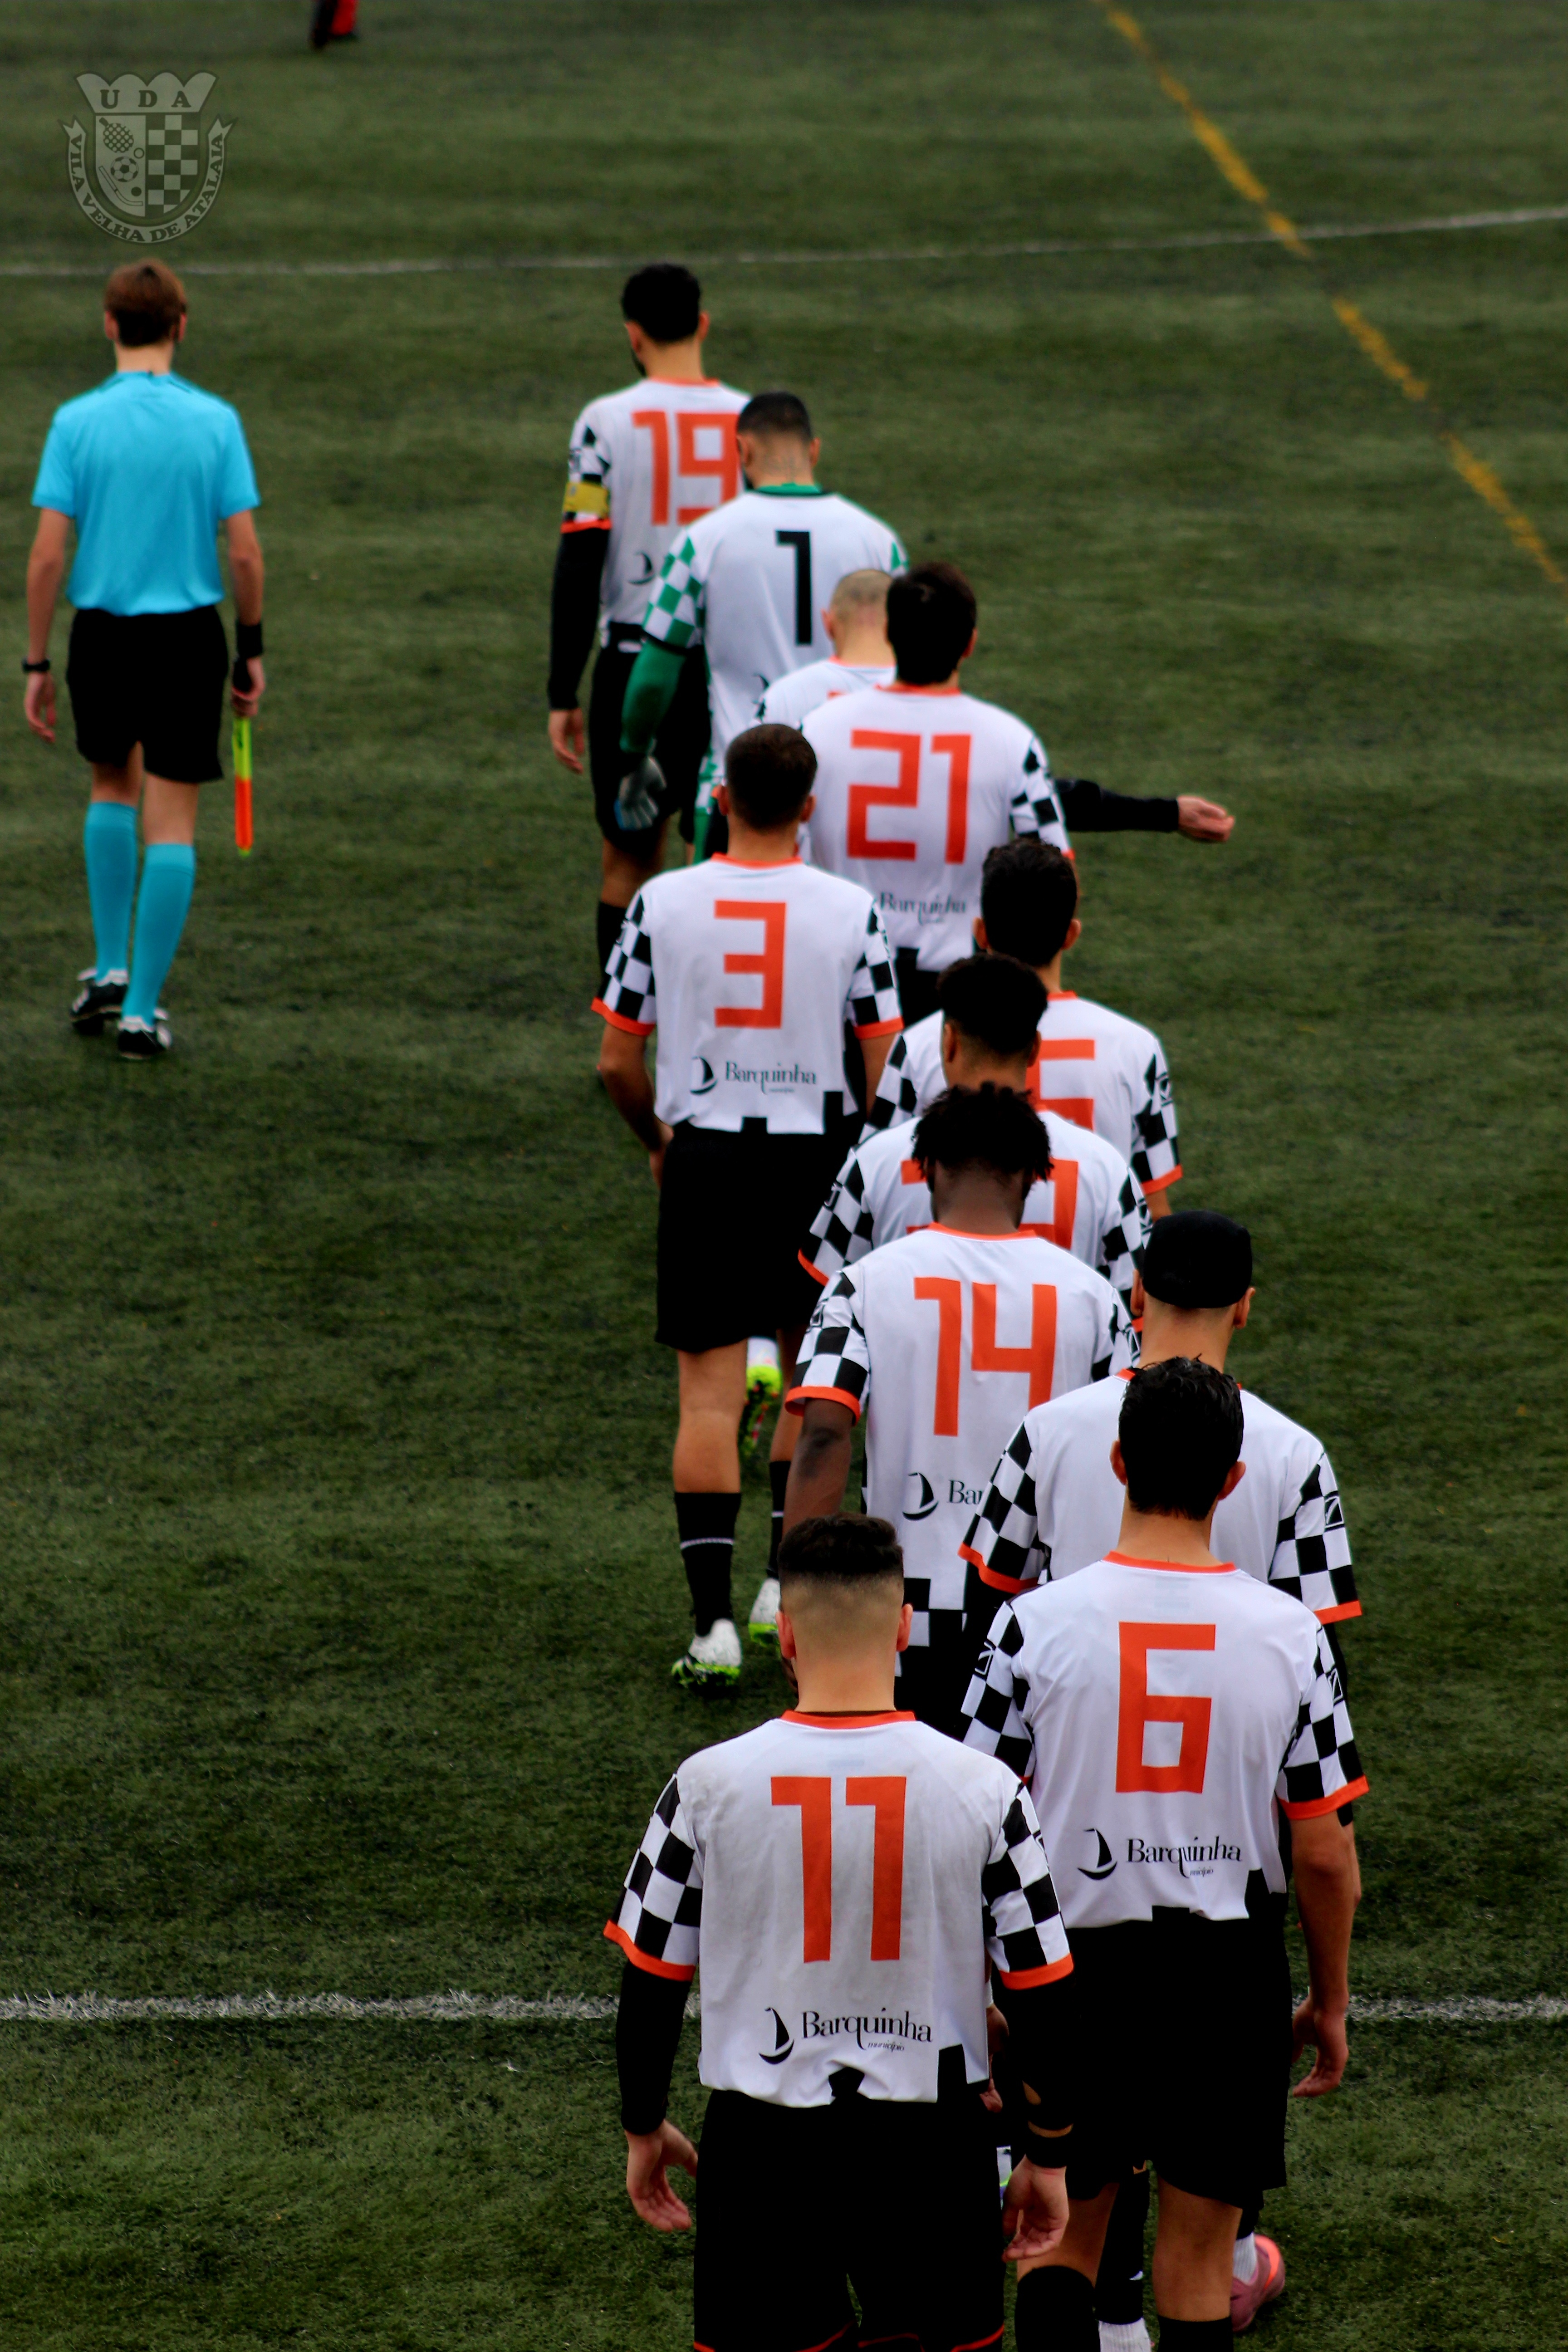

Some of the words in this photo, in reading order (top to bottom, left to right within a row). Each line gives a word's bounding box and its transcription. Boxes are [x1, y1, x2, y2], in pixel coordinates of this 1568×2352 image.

[631, 410, 738, 526] 19
[775, 530, 813, 646] 1
[847, 730, 971, 864] 21
[715, 900, 786, 1029] 3
[725, 1060, 817, 1095] Barquinha
[914, 1277, 1057, 1437] 14
[1116, 1621, 1216, 1793] 6
[770, 1776, 906, 1963] 11
[1126, 1835, 1242, 1878] Barquinha
[801, 2007, 933, 2050] Barquinha
